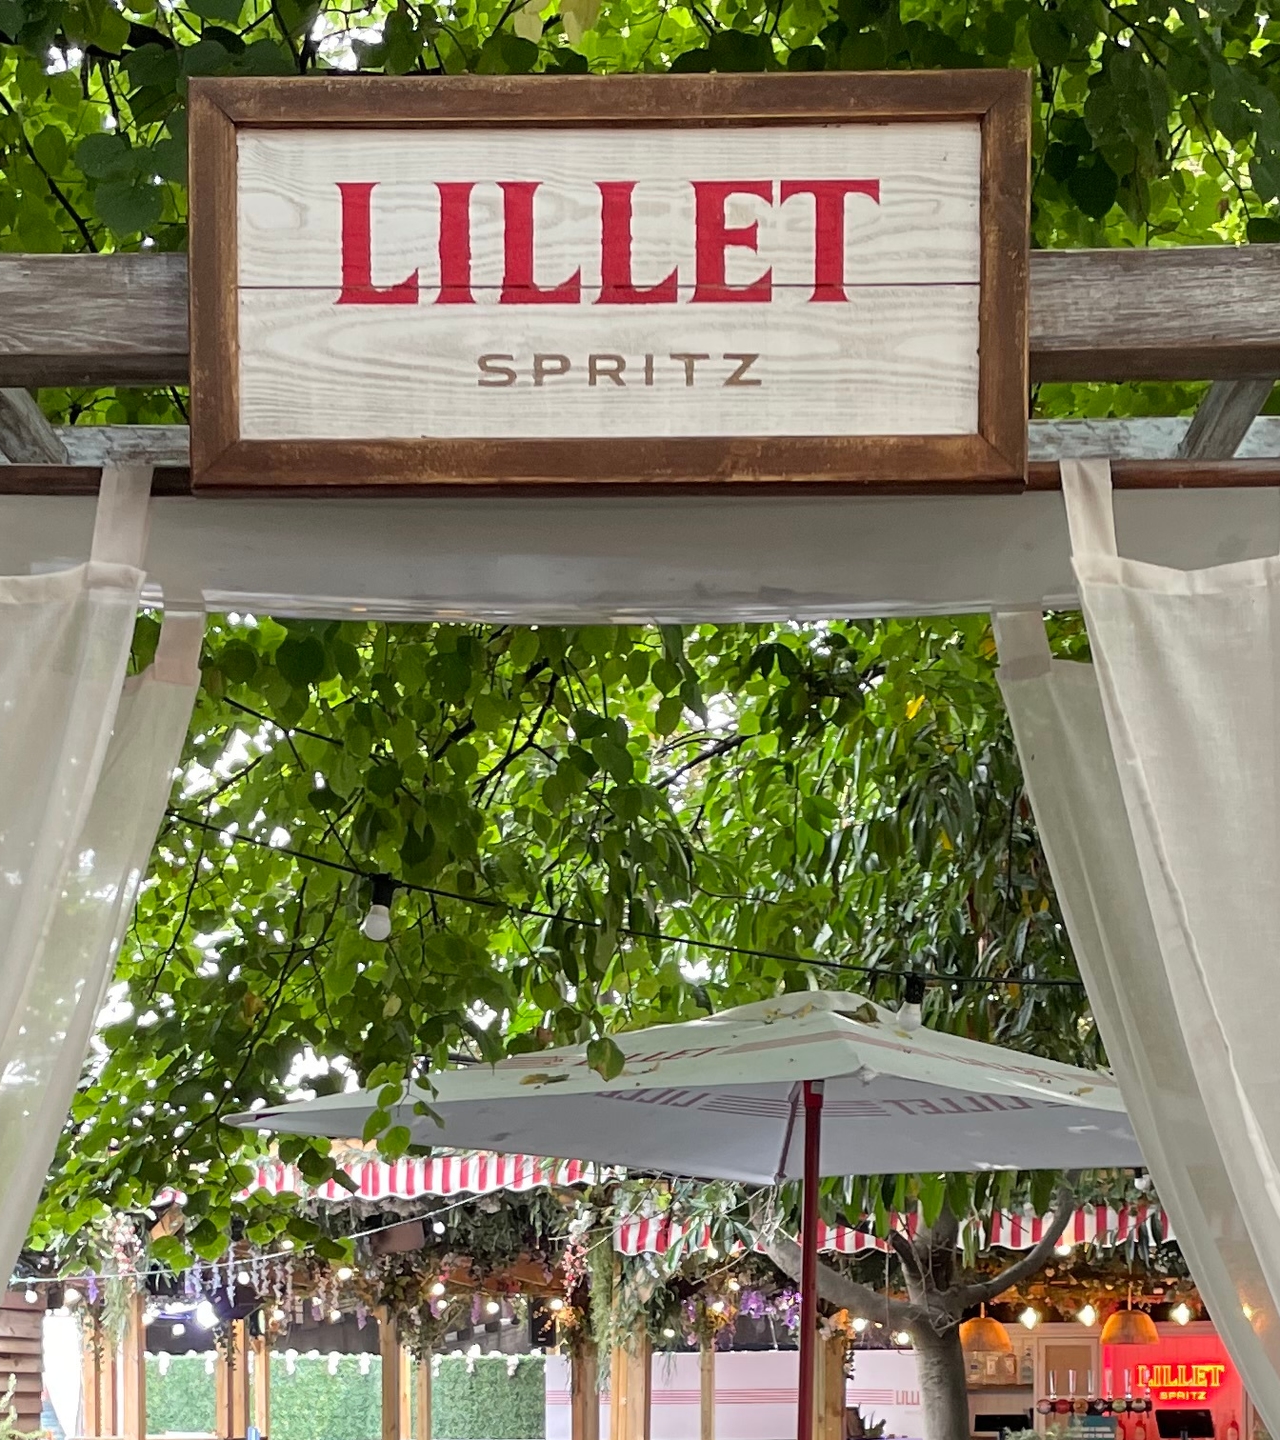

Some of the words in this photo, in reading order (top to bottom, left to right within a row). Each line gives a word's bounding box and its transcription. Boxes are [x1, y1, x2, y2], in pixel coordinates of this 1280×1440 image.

[335, 179, 880, 304] LILLET
[477, 353, 763, 387] SPRITZ
[574, 1045, 730, 1067] LLET
[1136, 1364, 1225, 1388] LILLET
[1159, 1391, 1207, 1400] SPRITZ
